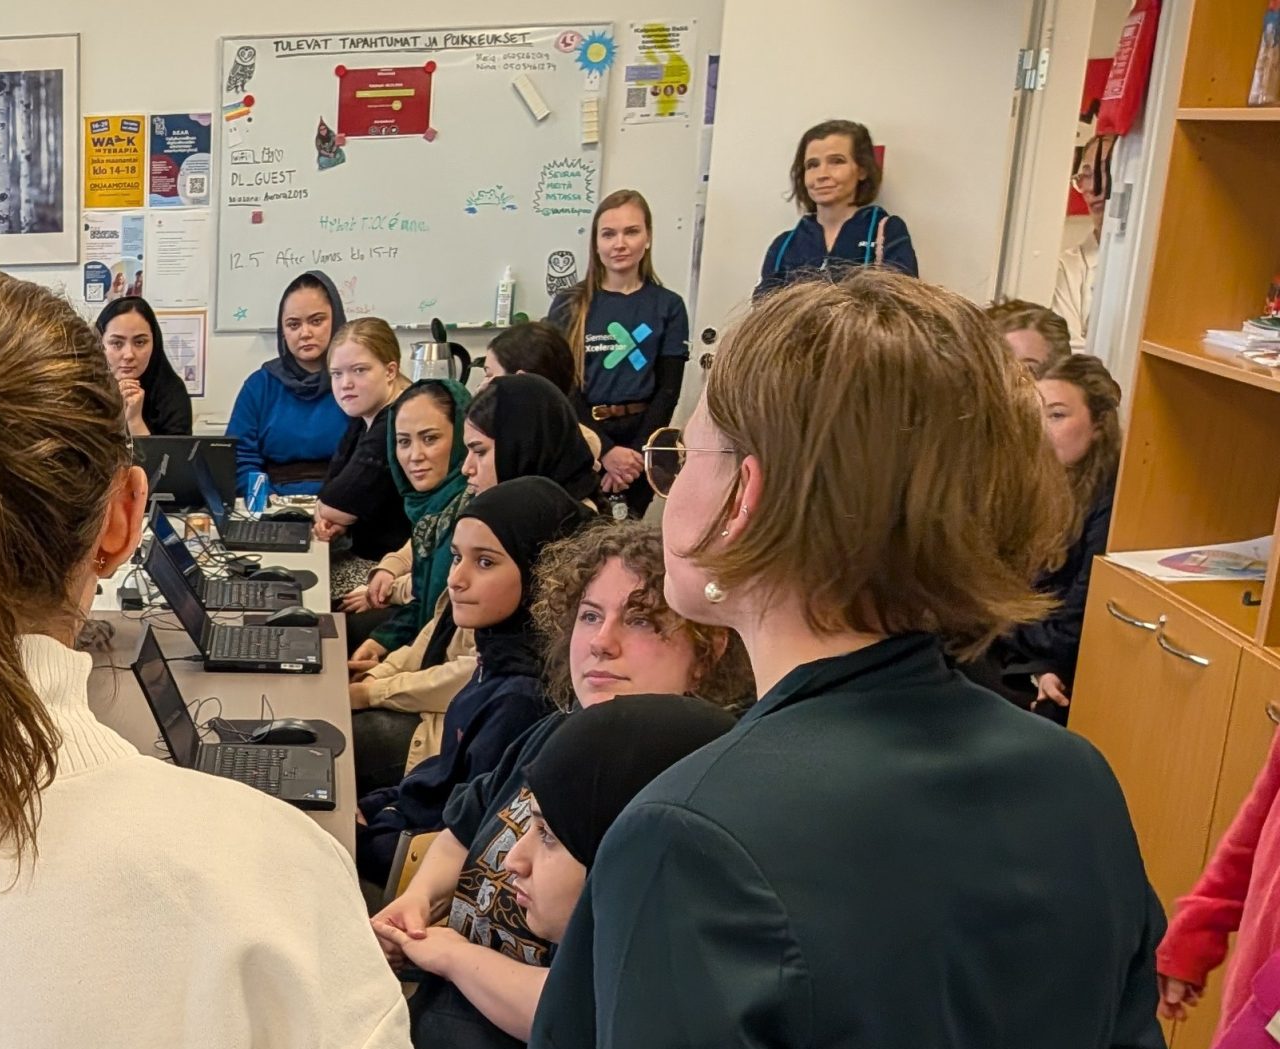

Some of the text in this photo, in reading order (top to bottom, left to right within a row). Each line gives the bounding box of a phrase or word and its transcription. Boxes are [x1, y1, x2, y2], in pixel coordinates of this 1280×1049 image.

[274, 32, 530, 52] TULEVAT TAPAHTUMAT JA POIKKEUKSET
[92, 166, 107, 175] klo
[231, 170, 296, 186] DL_GUEST
[230, 252, 264, 270] 12.5
[276, 249, 305, 268] After
[312, 250, 343, 266] Vamos
[585, 343, 627, 353] Xcelerator
